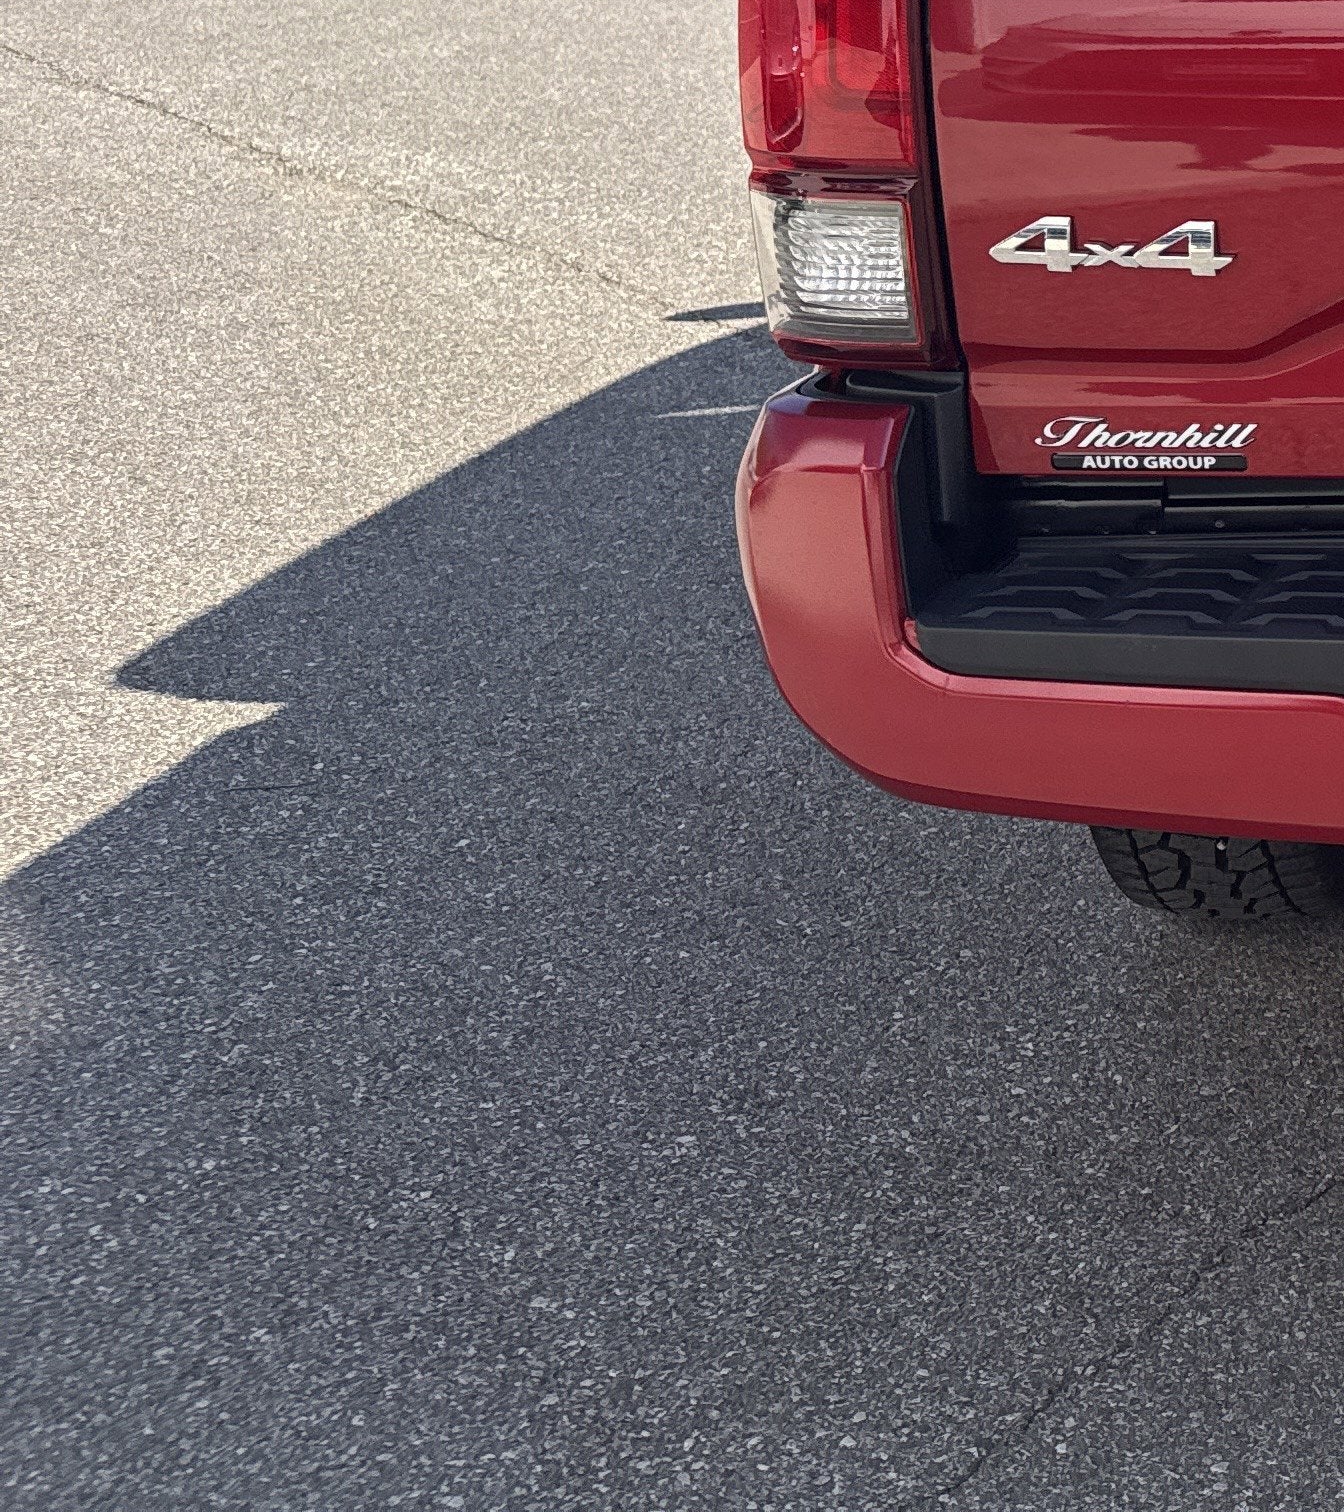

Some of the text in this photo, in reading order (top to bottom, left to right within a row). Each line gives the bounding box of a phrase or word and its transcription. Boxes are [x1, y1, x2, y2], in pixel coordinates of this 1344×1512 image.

[988, 215, 1237, 276] 4x4
[1034, 415, 1258, 449] Thornhill
[1082, 455, 1217, 470] AUTO GROUP
